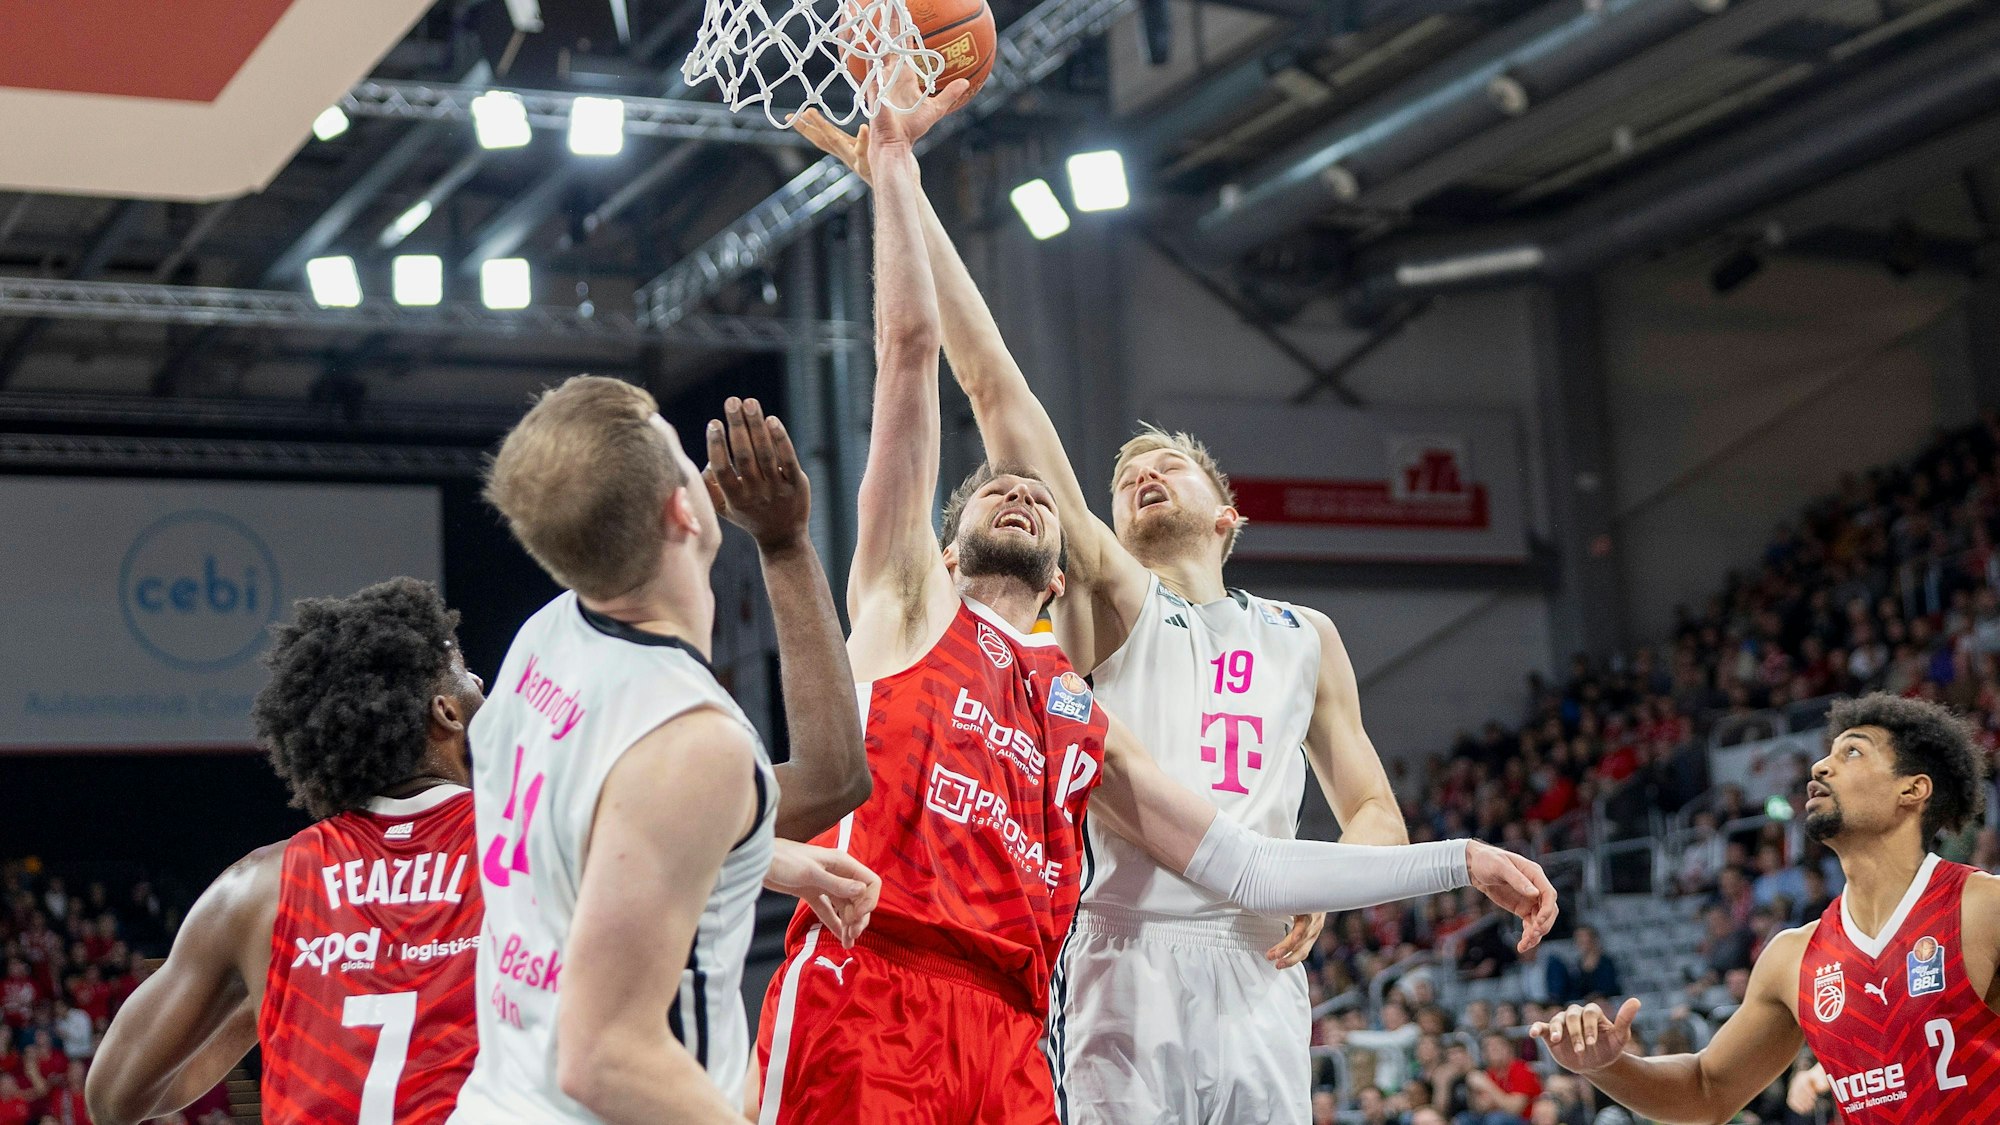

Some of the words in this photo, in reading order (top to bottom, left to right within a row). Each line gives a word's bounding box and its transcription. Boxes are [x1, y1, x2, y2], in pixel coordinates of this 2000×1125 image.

[137, 554, 257, 612] cebi
[515, 653, 586, 740] Kenndy
[1210, 650, 1254, 694] 19
[951, 718, 984, 735] Techn
[953, 686, 1046, 775] brose
[1051, 700, 1084, 718] BBL
[975, 789, 1062, 886] PROSAE
[322, 852, 468, 910] FEAZELL
[291, 927, 382, 976] xpd
[402, 935, 481, 961] logistics
[341, 961, 375, 973] global
[498, 932, 562, 993] Bask
[1912, 975, 1940, 992] BBL
[341, 991, 418, 1125] 7
[1924, 1018, 1968, 1091] 2
